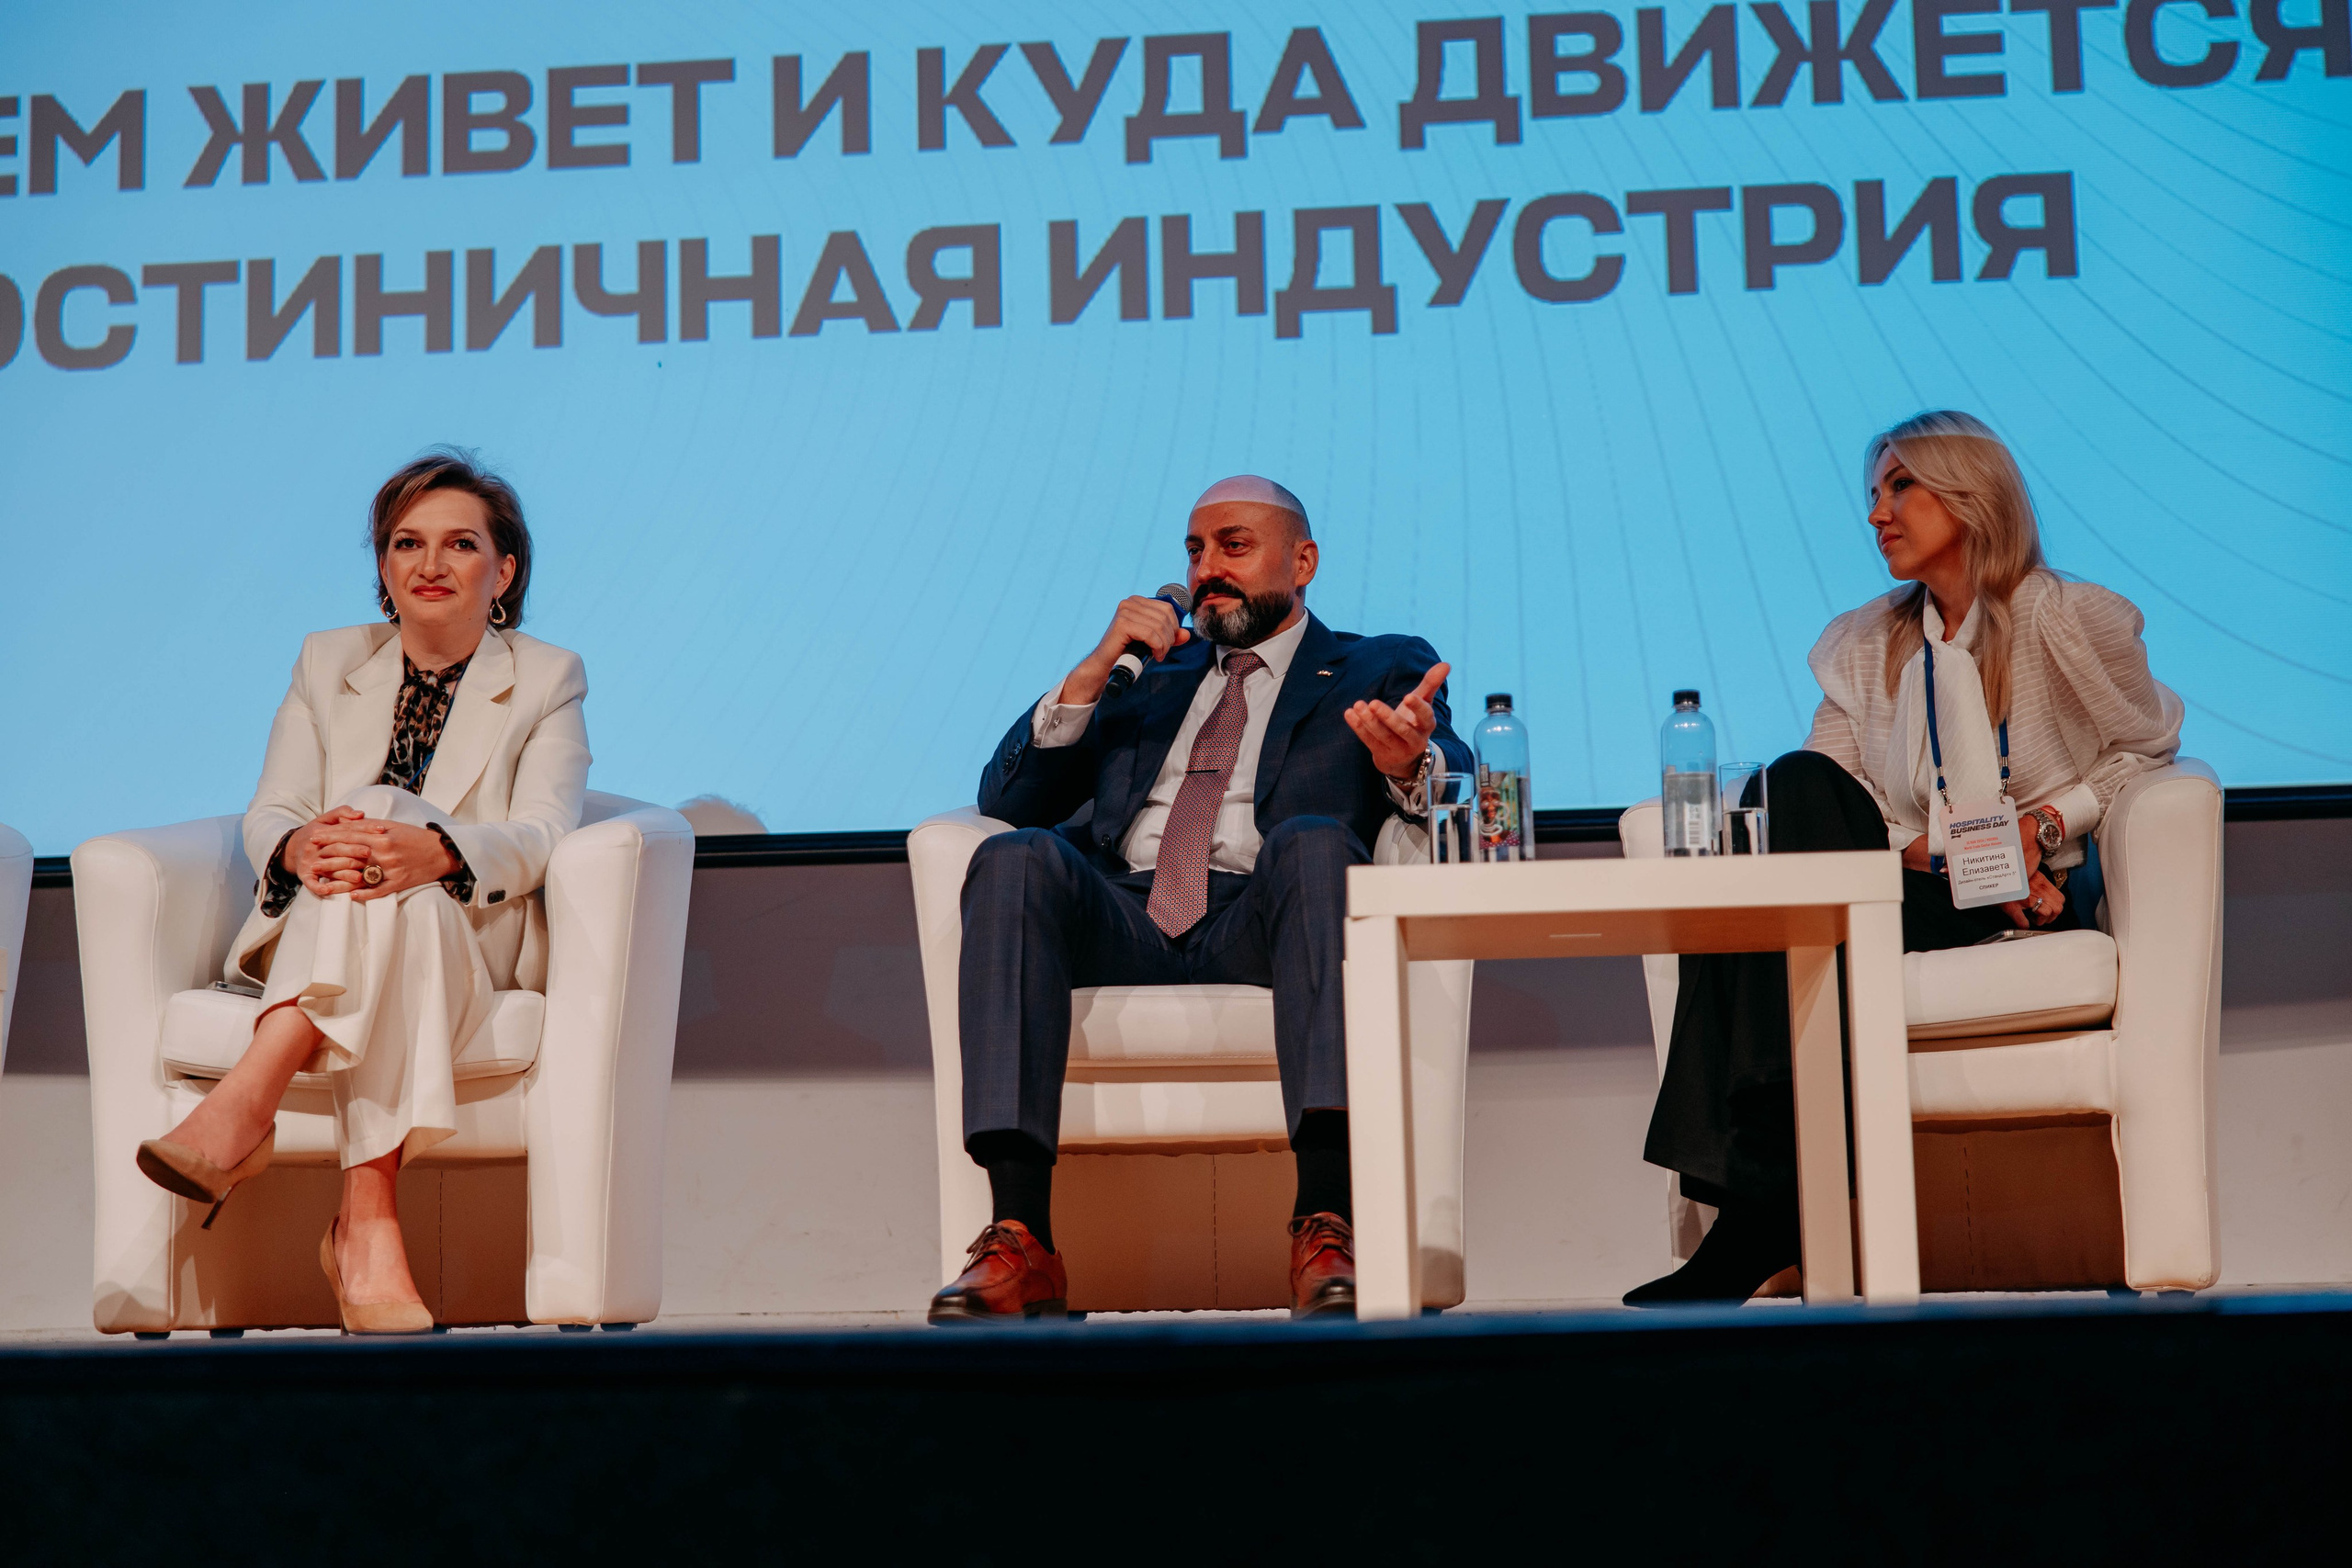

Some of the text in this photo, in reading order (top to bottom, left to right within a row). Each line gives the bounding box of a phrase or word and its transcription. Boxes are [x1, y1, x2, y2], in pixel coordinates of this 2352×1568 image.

[0, 0, 2352, 197] М ЖИВЕТ И КУДА ДВИЖЕТСЯ
[0, 171, 2079, 372] СТИНИЧНАЯ ИНДУСТРИЯ
[1950, 815, 2004, 829] HOSPITALITY
[1951, 820, 2009, 835] BUSINESS DAY
[1962, 852, 2006, 865] Никитина
[1962, 863, 2009, 876] Елизавета
